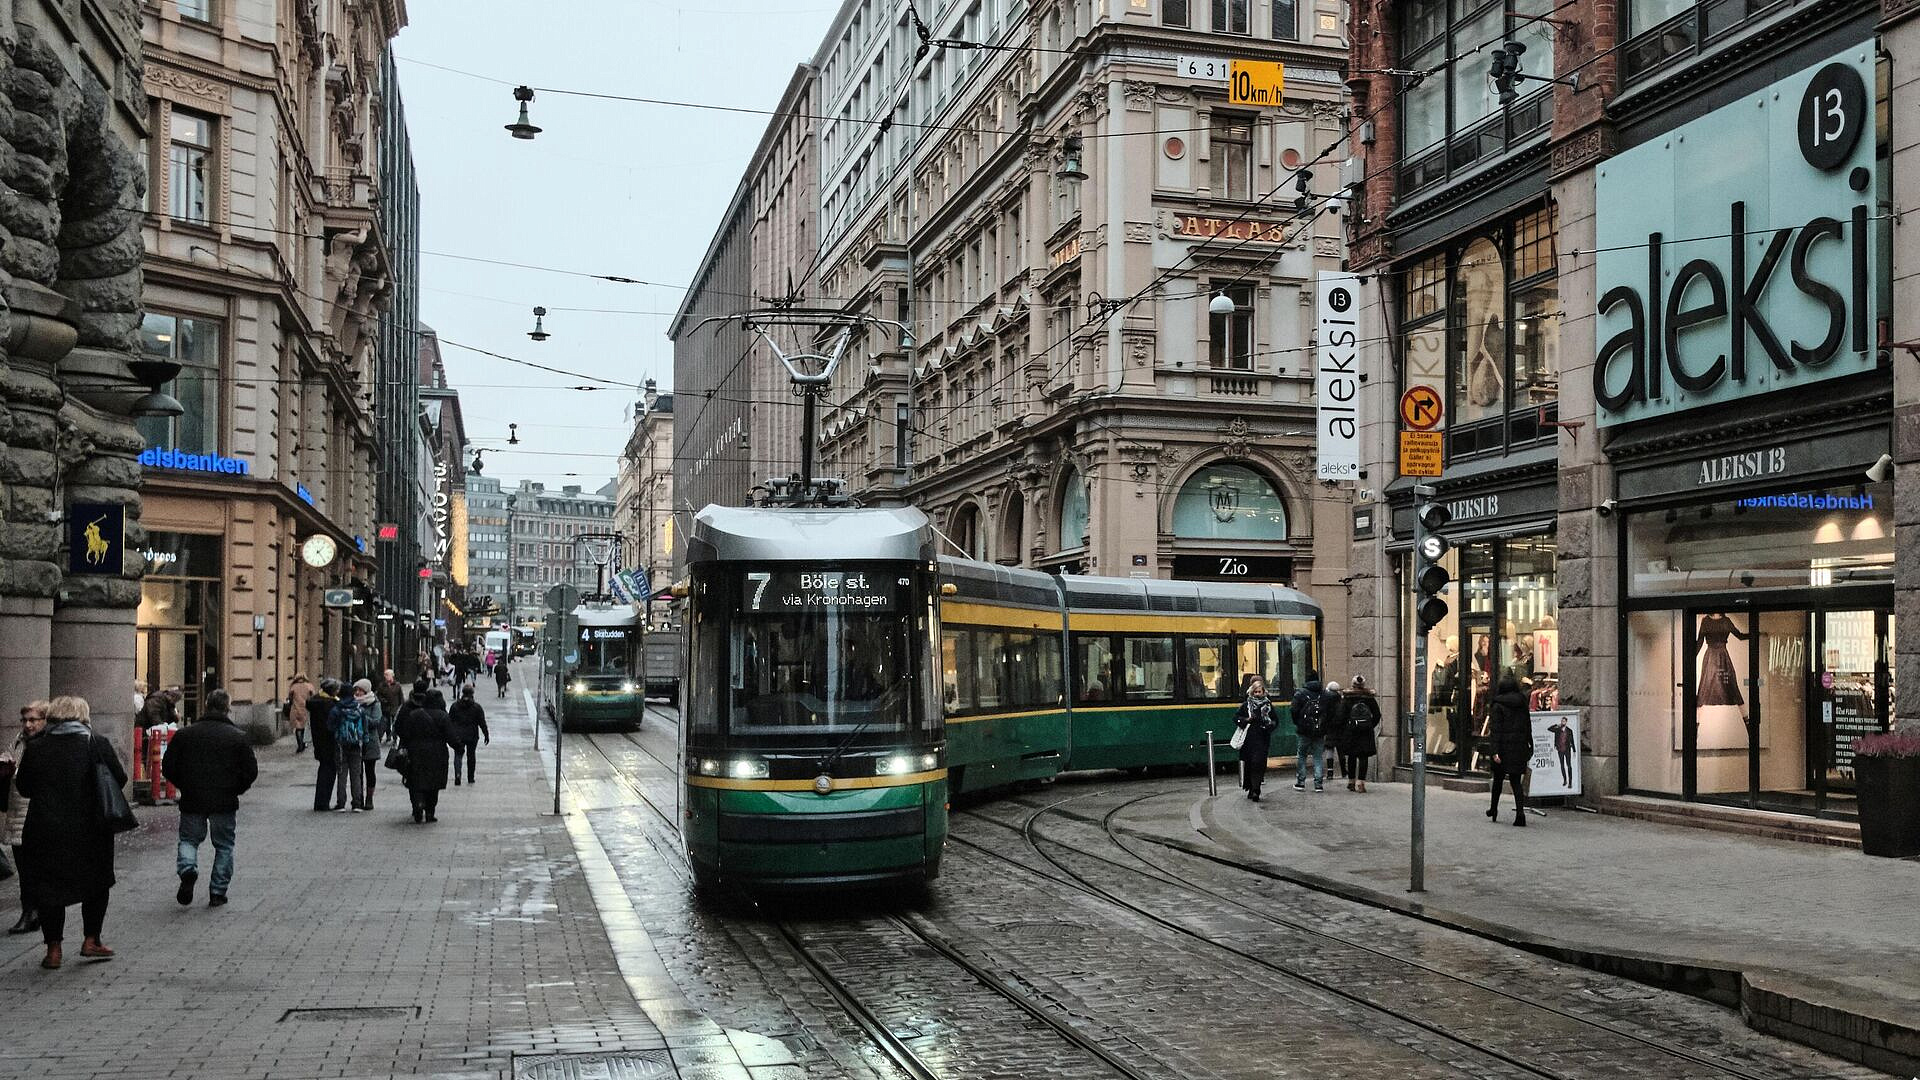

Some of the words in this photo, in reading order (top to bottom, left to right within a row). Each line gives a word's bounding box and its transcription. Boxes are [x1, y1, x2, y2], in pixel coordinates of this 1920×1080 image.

[1813, 88, 1846, 147] 13
[1183, 217, 1283, 243] ATLAS
[1333, 292, 1346, 307] 13
[1593, 166, 1870, 411] aleksi
[1320, 318, 1355, 440] aleksi
[1321, 463, 1350, 475] aleksi
[1698, 451, 1763, 485] ALEKSI
[1768, 447, 1785, 474] 13
[1487, 494, 1498, 516] 13
[1220, 558, 1248, 575] Zio
[748, 572, 771, 610] 7
[800, 573, 839, 590] Böle
[846, 574, 870, 589] st.
[898, 578, 909, 586] 470
[782, 593, 803, 606] via
[807, 593, 887, 608] Kronohagen
[581, 628, 590, 641] 4
